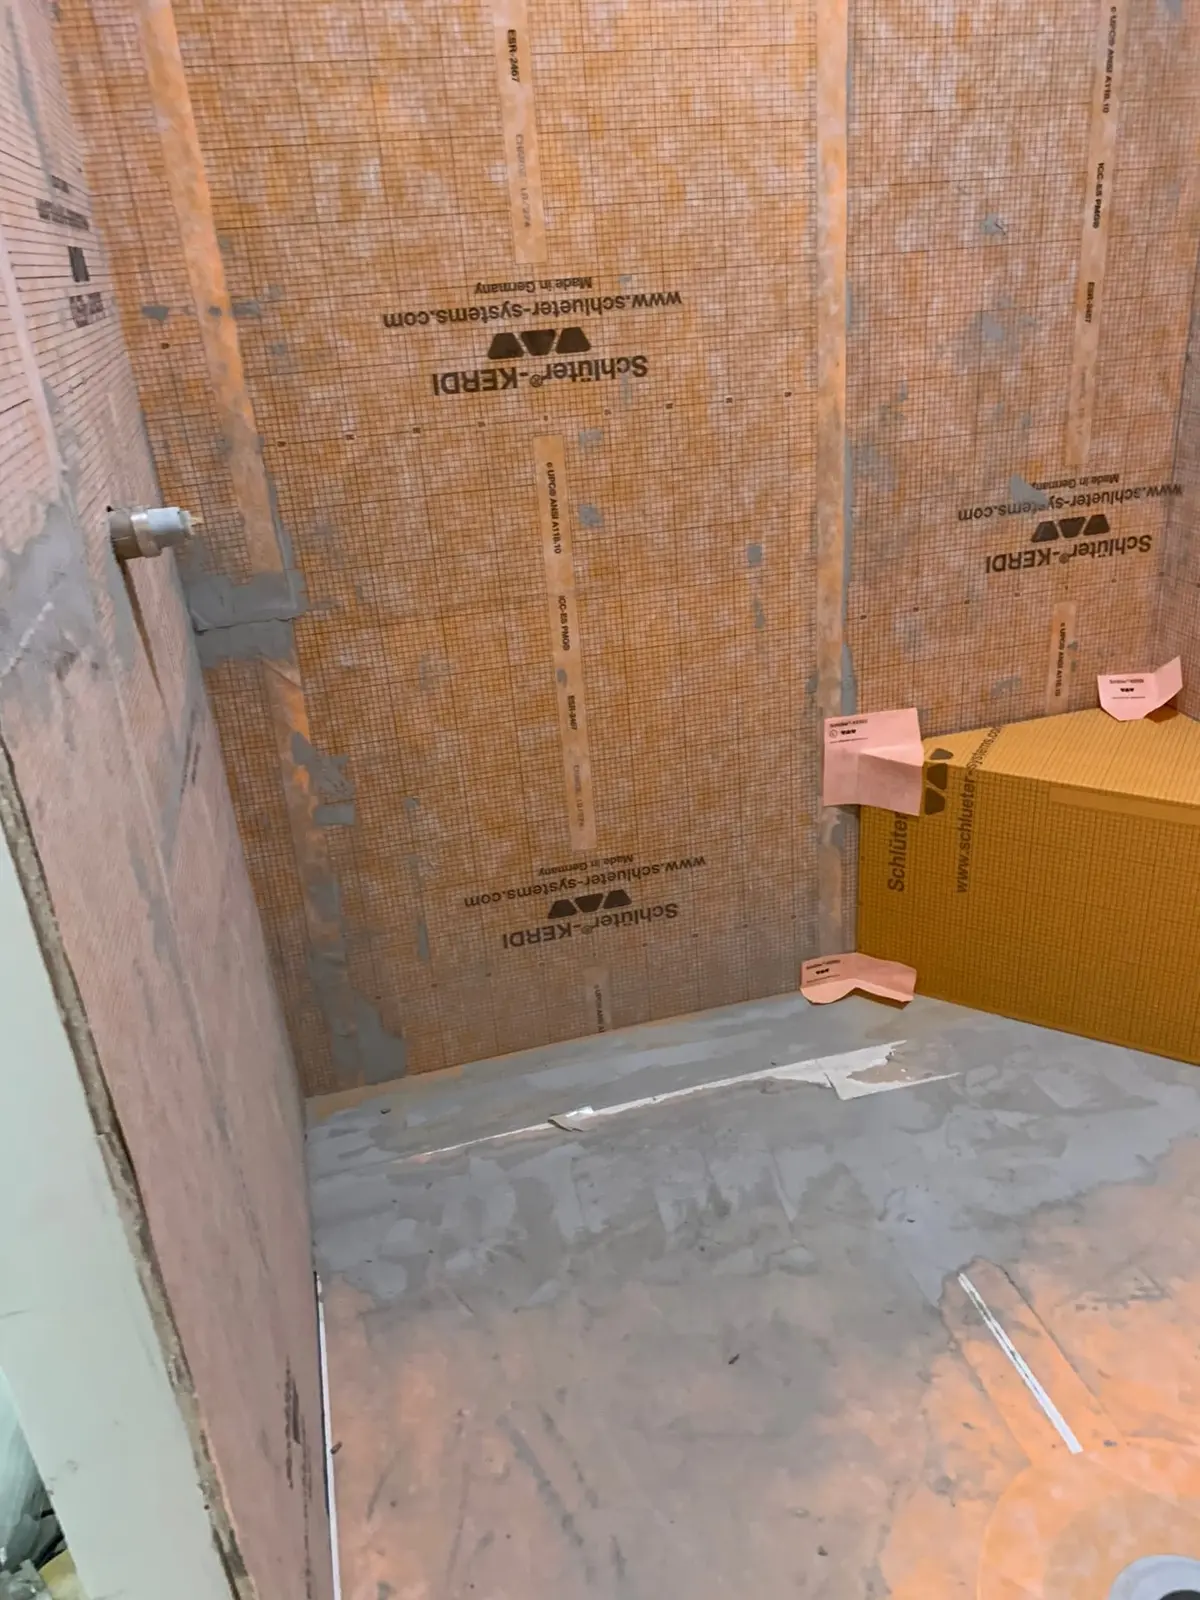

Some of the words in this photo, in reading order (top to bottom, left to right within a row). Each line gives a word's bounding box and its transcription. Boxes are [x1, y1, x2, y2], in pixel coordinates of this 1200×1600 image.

[507, 29, 520, 82] ESR-2467
[475, 281, 535, 294] Germany
[540, 279, 554, 290] in
[556, 277, 592, 289] Made
[383, 292, 682, 328] www.schlueter-systems.com
[1079, 477, 1088, 486] in
[1089, 474, 1119, 485] Made
[549, 498, 560, 520] ANSI
[958, 484, 1183, 521] www.schlueter-sytems.com
[589, 859, 600, 868] in
[603, 854, 634, 865] Made
[539, 862, 588, 876] Germany
[464, 857, 706, 907] www.schlueter-systems.com
